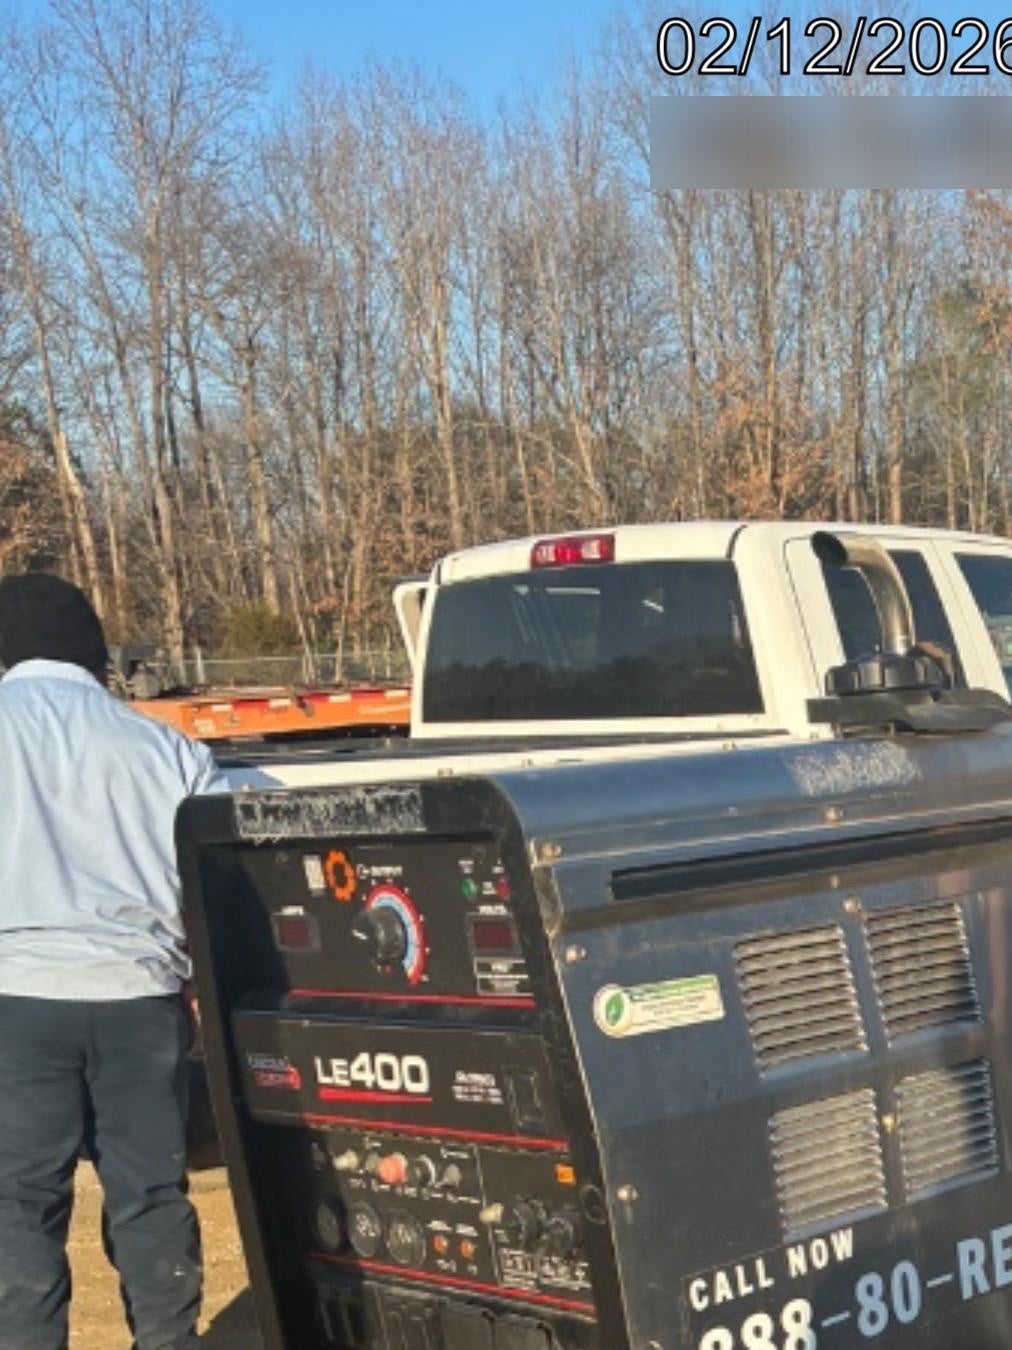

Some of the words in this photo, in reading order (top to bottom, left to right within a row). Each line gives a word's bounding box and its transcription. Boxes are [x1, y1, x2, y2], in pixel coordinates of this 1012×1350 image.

[314, 1052, 430, 1093] LE400
[688, 1257, 774, 1312] CALL
[787, 1227, 854, 1279] NOW
